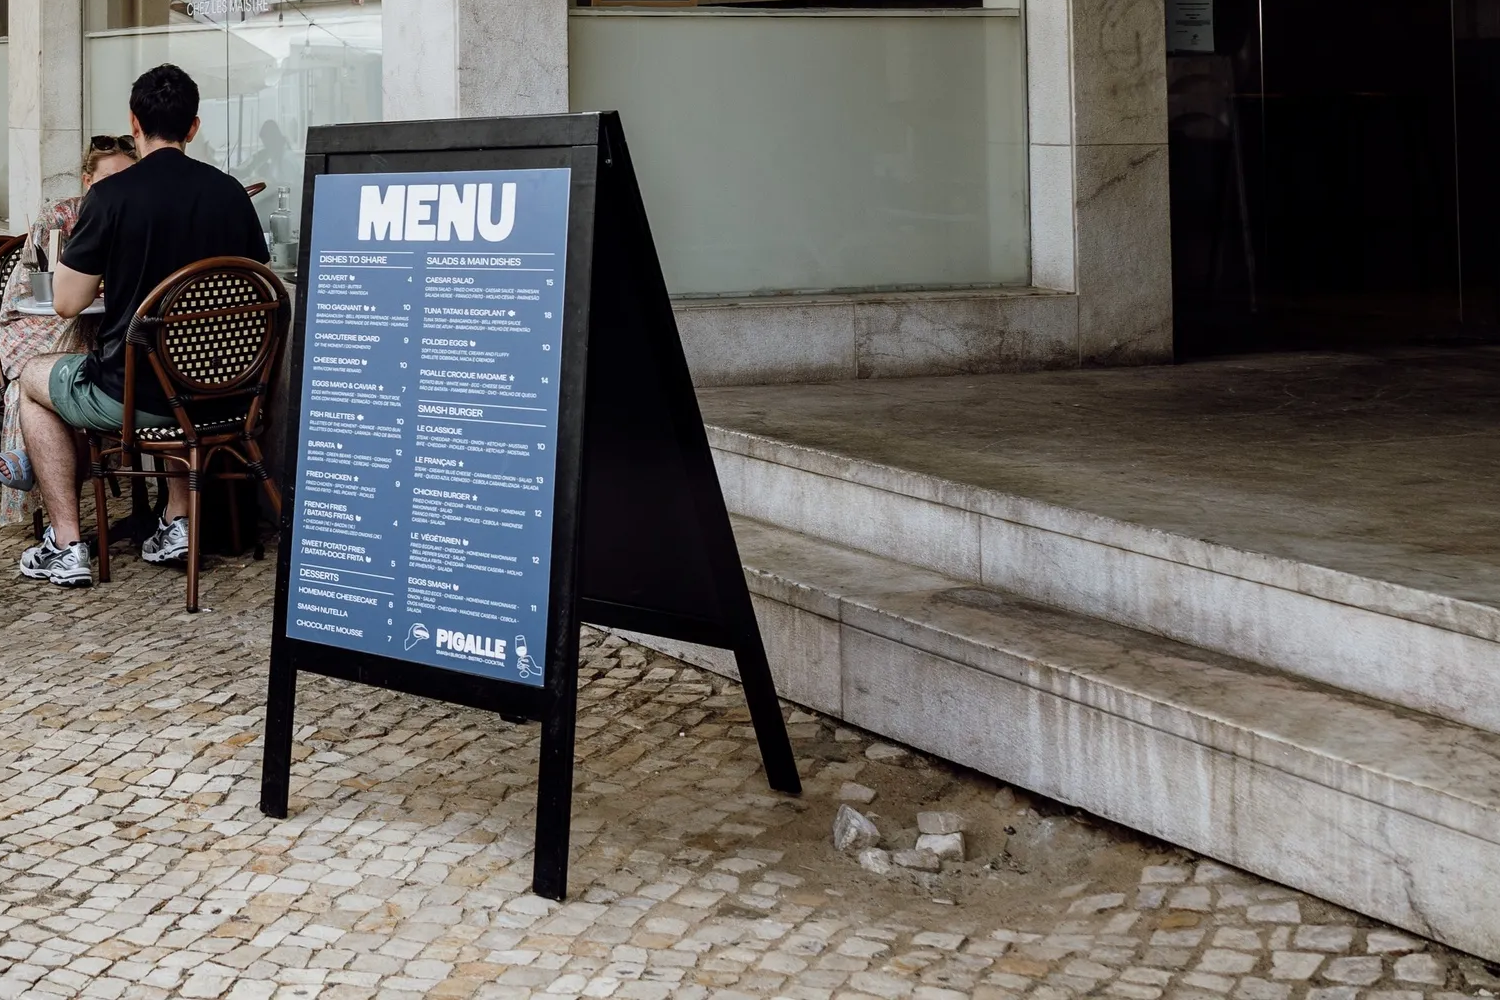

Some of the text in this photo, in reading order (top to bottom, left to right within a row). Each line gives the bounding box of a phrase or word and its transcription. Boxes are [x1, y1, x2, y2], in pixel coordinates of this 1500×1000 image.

[186, 3, 210, 16] CHEZ
[211, 0, 228, 14] LES
[358, 183, 516, 242] MENU
[361, 256, 387, 264] SHARE
[427, 257, 458, 265] SALADS
[459, 257, 466, 265] &
[490, 258, 521, 266] DISHES
[470, 309, 506, 317] EGGPLANT
[315, 333, 357, 341] CHARCUTERIE
[422, 338, 448, 346] FOLDED
[542, 344, 550, 352] 10
[313, 356, 337, 364] CHEESE
[420, 369, 446, 378] PIGALLE
[447, 371, 476, 379] CROQUE
[477, 373, 507, 381] MADAME
[324, 412, 355, 420] RILLETTES
[418, 405, 483, 418] SMASH BURGER
[425, 425, 463, 435] CLASSIQUE
[308, 440, 335, 449] BURRATA
[423, 457, 457, 467] FRANÇAIS
[306, 470, 323, 478] FRIED
[324, 472, 352, 481] CHICKEN
[413, 488, 470, 500] CHICKEN BURGER
[304, 500, 347, 511] FRENCH FRIES
[307, 509, 333, 518] BATATAS
[333, 512, 354, 521] FRITAS
[534, 509, 542, 517] 12
[301, 539, 365, 554] SWEET POTATO FRIES
[410, 532, 540, 564] LE VÉGÉTARIEN 12
[305, 547, 346, 560] BATATA-DOCE
[347, 554, 363, 562] FRITA
[300, 568, 339, 581] DESSERTS
[298, 587, 335, 598] HOMEMADE
[336, 592, 378, 605] CHEESECAKE
[408, 577, 537, 612] EGGS SMASH 11
[297, 603, 320, 612] SMASH
[320, 606, 348, 617] NUTELLA
[297, 619, 335, 632] CHOCOLATE
[336, 626, 363, 637] MOUSSE
[436, 628, 507, 660] PIGALLE
